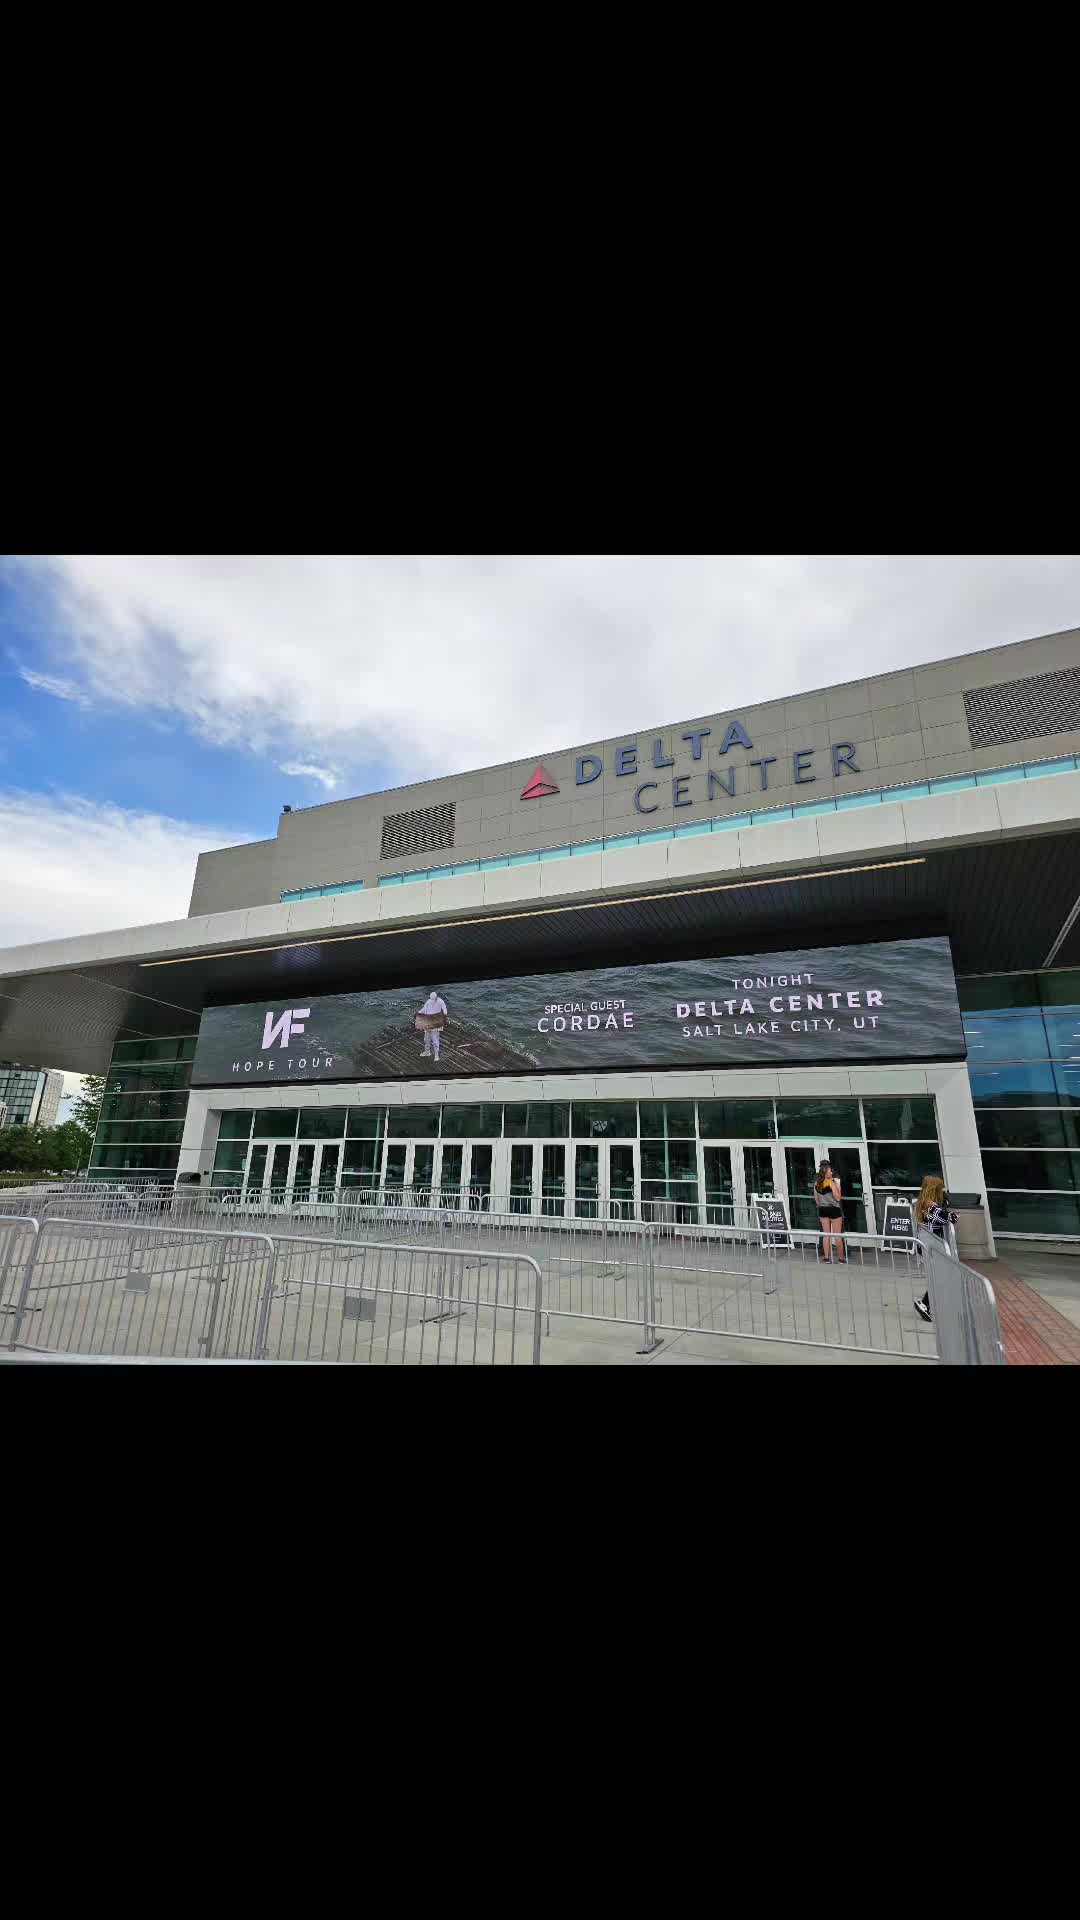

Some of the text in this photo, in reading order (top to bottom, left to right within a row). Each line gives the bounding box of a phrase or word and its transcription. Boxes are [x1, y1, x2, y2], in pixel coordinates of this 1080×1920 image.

[575, 719, 752, 786] DELTA
[633, 741, 861, 813] CENTER
[732, 973, 815, 990] TONIGHT
[544, 1000, 627, 1014] SPECIAL GUEST
[676, 990, 884, 1018] DELTA CENTER
[537, 1012, 634, 1033] CORDAE
[682, 1024, 723, 1037] SALT
[734, 1021, 780, 1035] LAKE
[853, 1016, 879, 1029] UT
[232, 1057, 333, 1072] HOPE TOUR
[890, 1217, 911, 1225] ENTER
[891, 1224, 909, 1232] HERE
